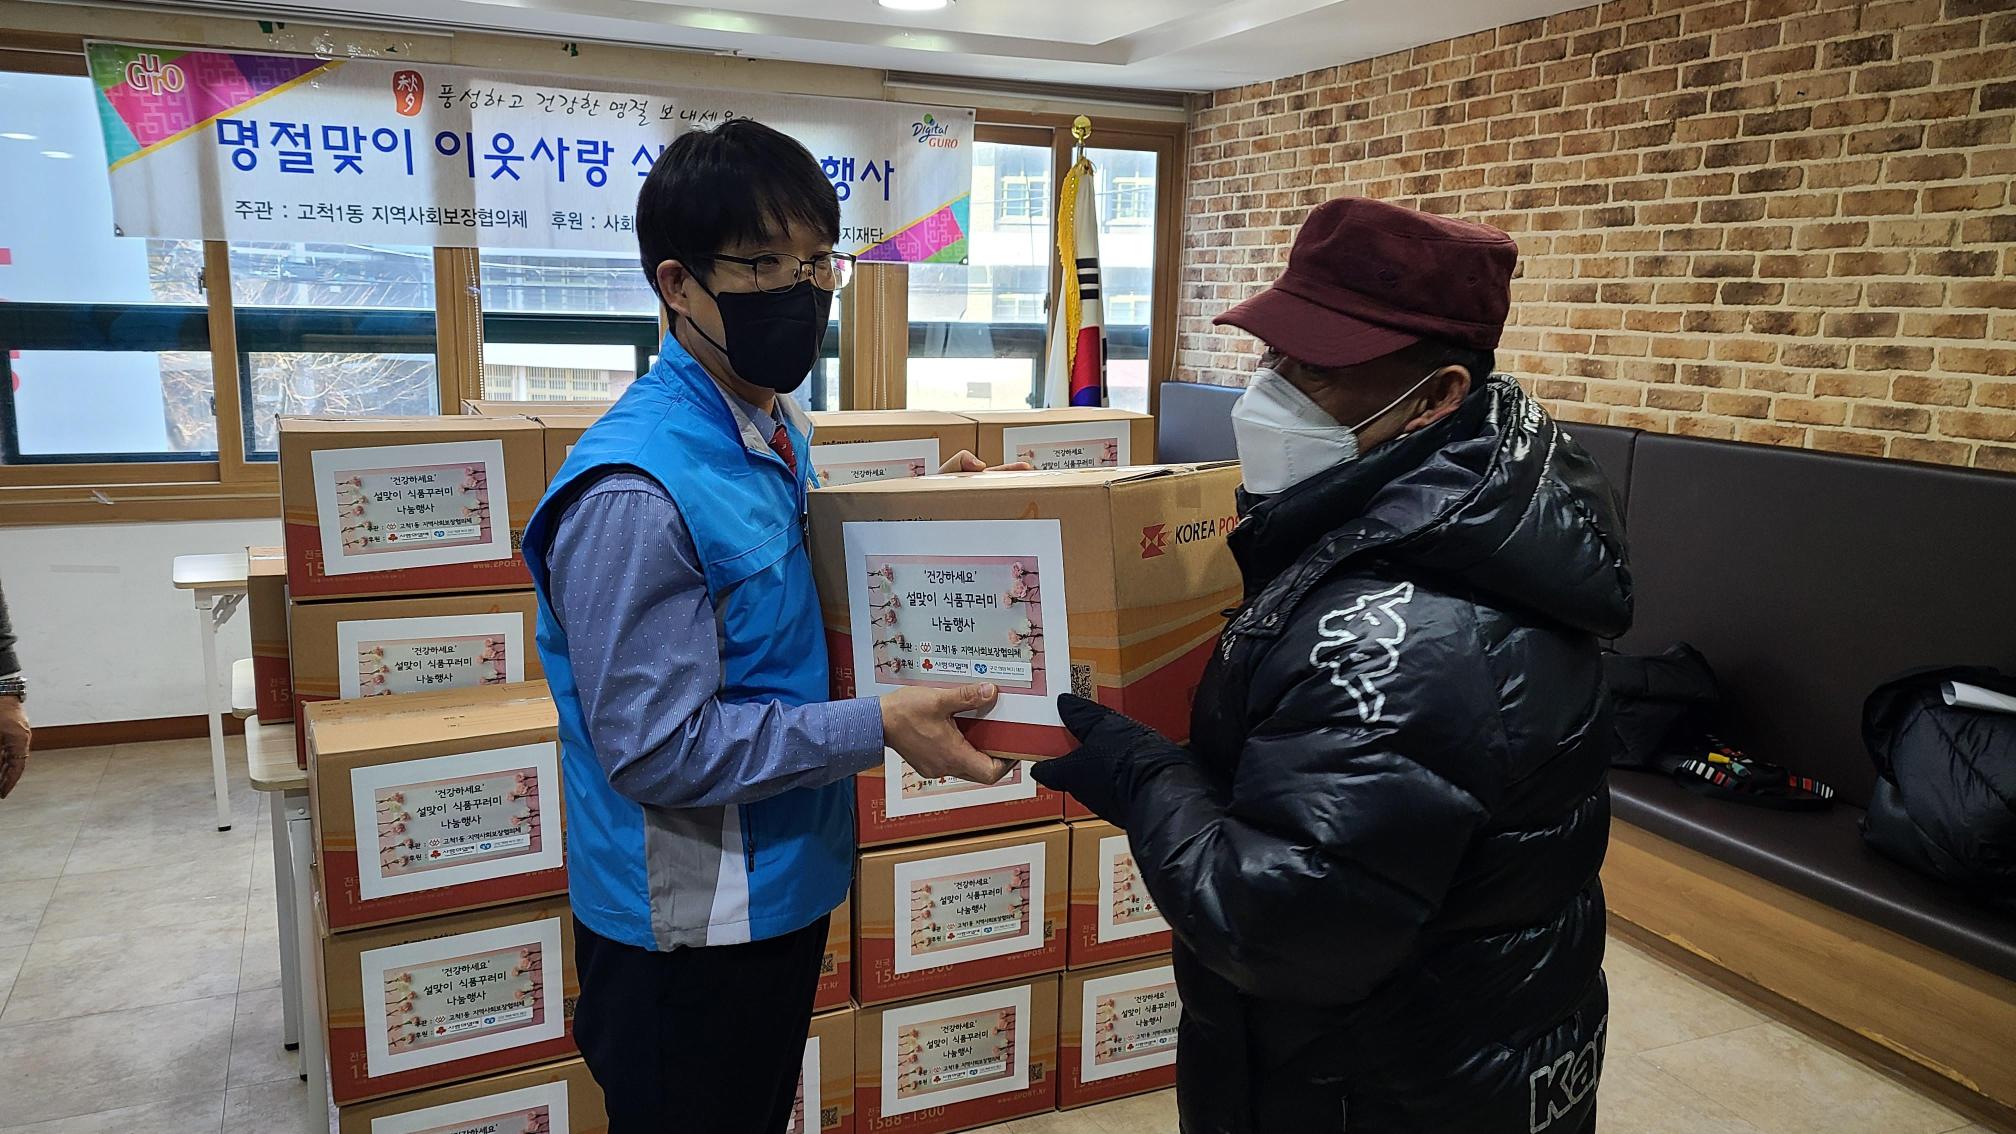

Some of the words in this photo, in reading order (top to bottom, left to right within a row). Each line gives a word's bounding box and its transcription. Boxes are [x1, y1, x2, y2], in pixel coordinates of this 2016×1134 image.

[437, 84, 525, 109] 풍성하고
[536, 92, 600, 117] 건강한
[609, 99, 651, 127] 명절
[912, 121, 949, 143] Digital
[929, 138, 958, 148] GURO
[216, 118, 414, 175] 명절맞이
[434, 130, 614, 187] 이웃사랑
[234, 201, 273, 219] 주관
[297, 203, 364, 223] 고척1동
[372, 207, 528, 229] 지역사회보장협의체
[551, 211, 583, 230] 후원
[373, 490, 402, 501] 설맞이
[407, 487, 453, 499] 식품꾸러미
[397, 504, 435, 515] 나눔행사
[1175, 519, 1216, 544] KOREA
[924, 569, 978, 584] '건강하세요'
[906, 592, 937, 607] 설맞이
[944, 593, 998, 609] 식품꾸러미
[932, 617, 976, 632] 나눔행사
[934, 644, 958, 656] 고척1동
[961, 646, 1022, 659] 지역사회보장협의체
[395, 660, 422, 671] 설맞이
[427, 657, 473, 669] 식품꾸러미
[901, 659, 914, 669] 후원
[416, 674, 453, 684] 나눔행사
[435, 783, 486, 798] '건강하세요'
[416, 804, 447, 817] 설맞이
[453, 796, 502, 811] 식품꾸러미
[441, 815, 481, 829] 나눔행사
[940, 894, 962, 905] 설맞이
[966, 887, 1003, 901] 식품꾸러미
[956, 904, 986, 916] 나눔행사
[441, 960, 490, 977] '건강하세요'
[423, 981, 453, 996] 설맞이
[458, 971, 506, 989] 식품꾸러미
[447, 990, 486, 1005] 나눔행사
[1122, 1007, 1141, 1018] 설맞이
[1145, 1001, 1177, 1013] 식품꾸러미
[1136, 1016, 1162, 1027] 나눔행사
[927, 1037, 948, 1049] 설맞이
[953, 1030, 989, 1046] 식품꾸러미
[943, 1046, 972, 1058] 나눔행사
[867, 1106, 945, 1131] 1588-1300
